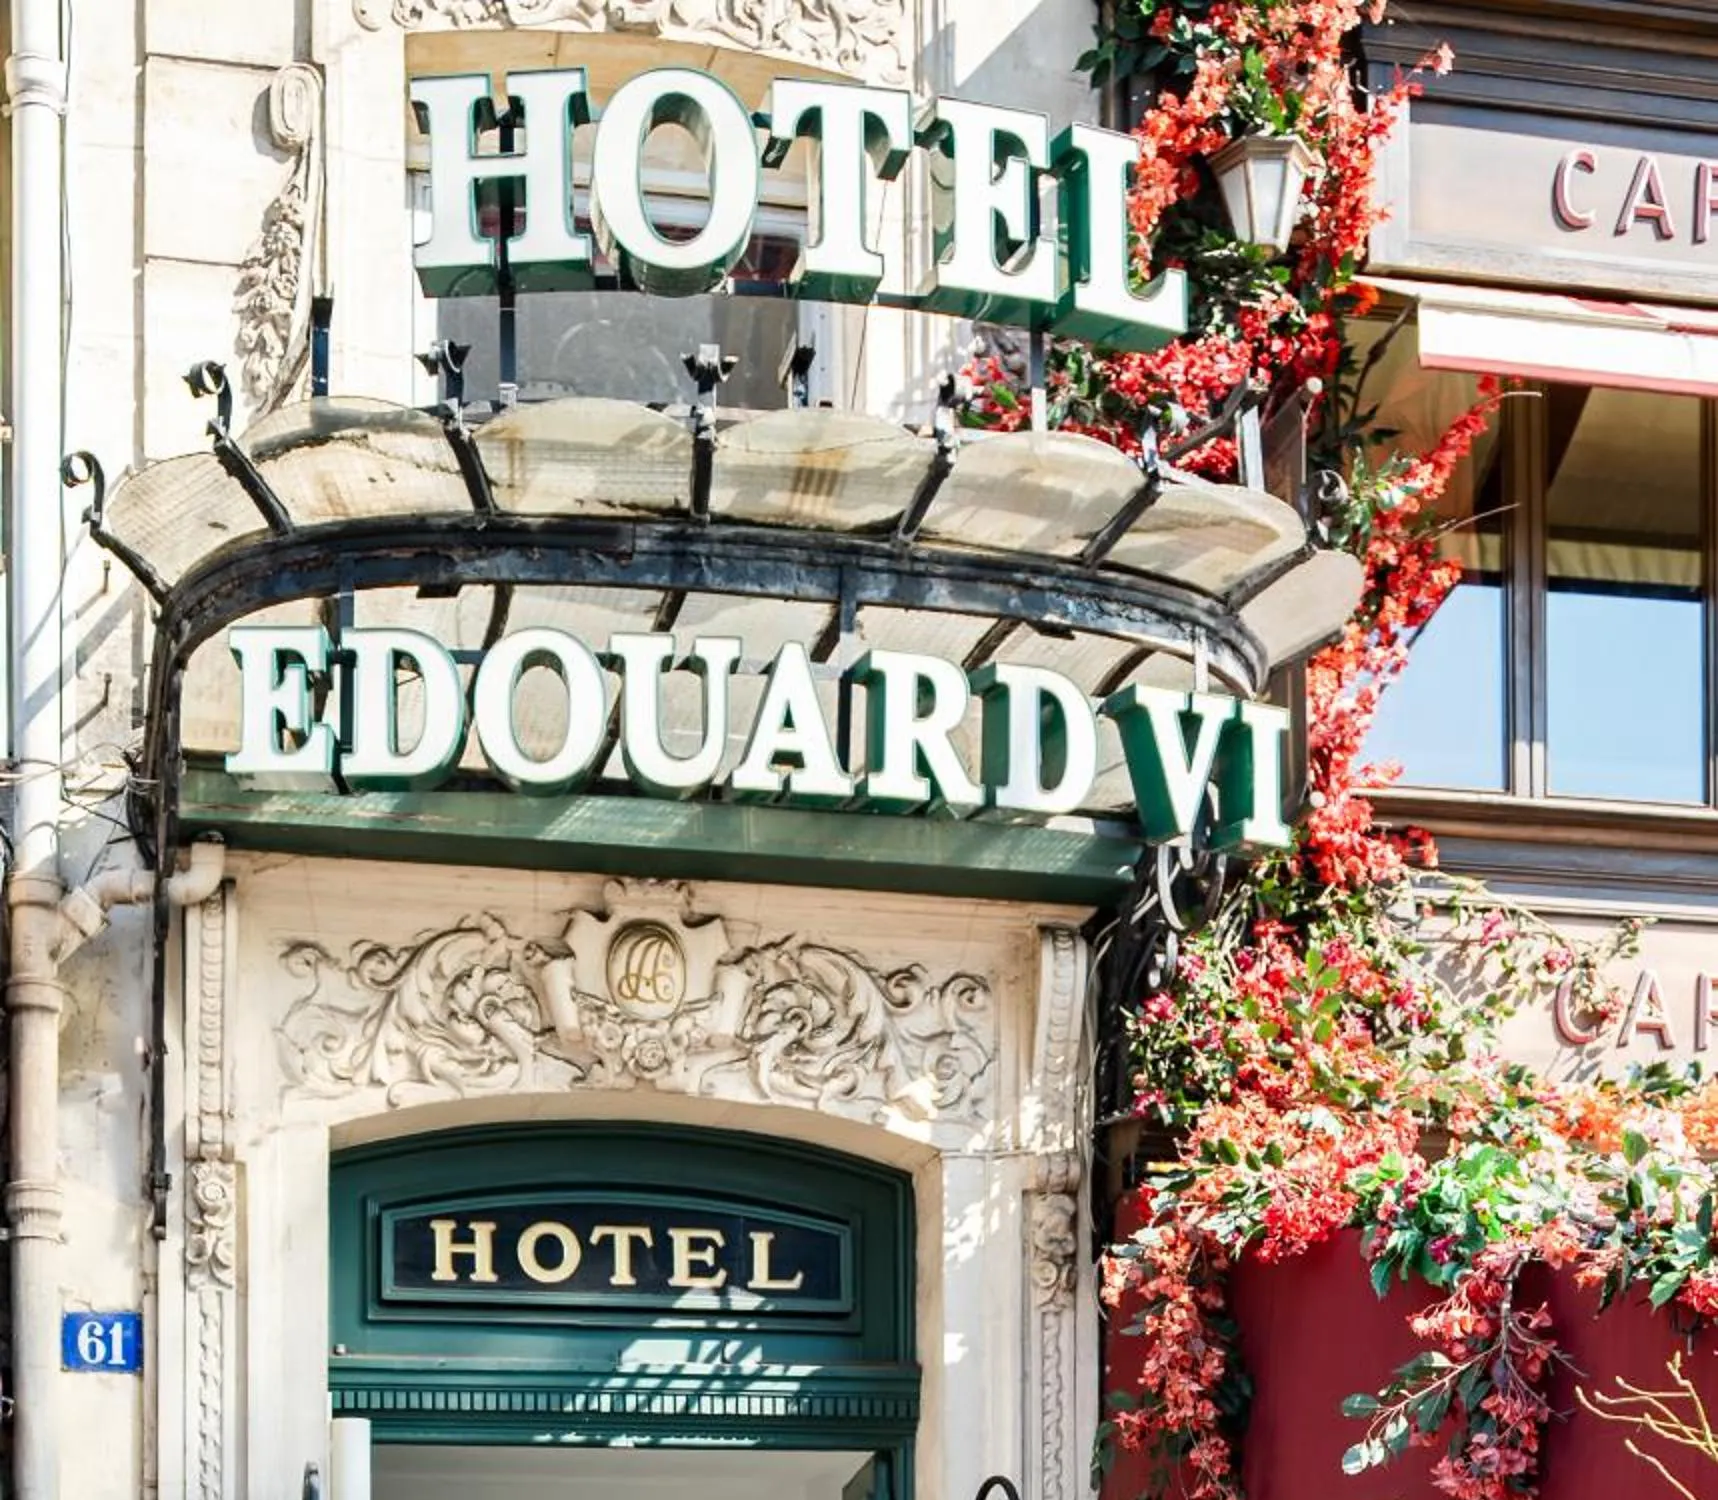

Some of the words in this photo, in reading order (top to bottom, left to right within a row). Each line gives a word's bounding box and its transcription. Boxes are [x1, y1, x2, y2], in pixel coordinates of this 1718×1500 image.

[411, 67, 1188, 340] HOTEL
[224, 625, 1100, 817] EDOUARD
[1132, 685, 1291, 848] VI
[429, 1219, 804, 1291] HOTEL
[77, 1321, 127, 1365] 61
